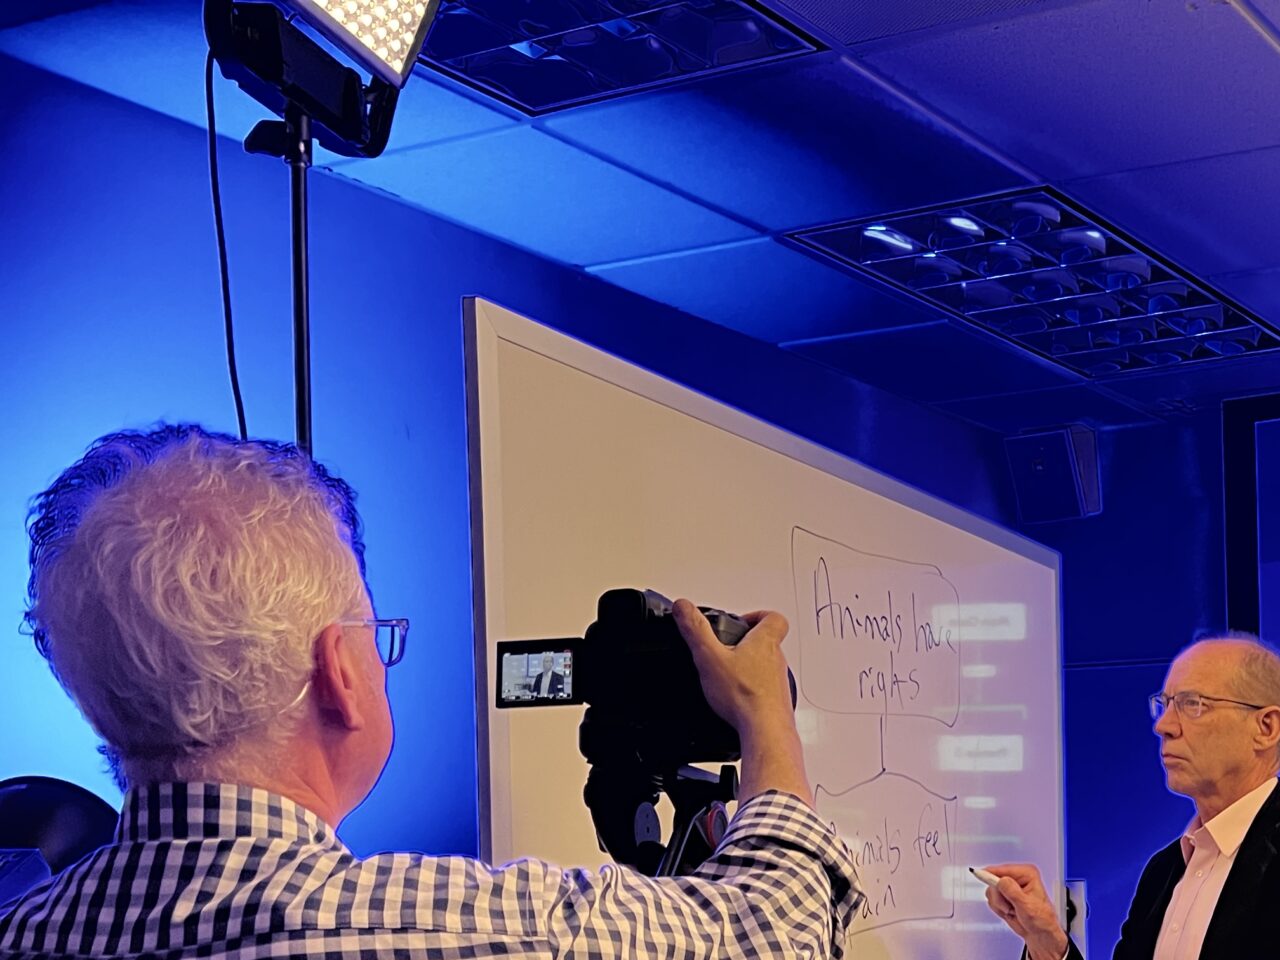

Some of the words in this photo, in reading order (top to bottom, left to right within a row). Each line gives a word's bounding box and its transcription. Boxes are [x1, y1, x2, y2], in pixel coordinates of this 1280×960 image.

[814, 556, 902, 653] Animals
[911, 592, 957, 654] have
[858, 650, 920, 731] rights
[912, 802, 954, 868] feel
